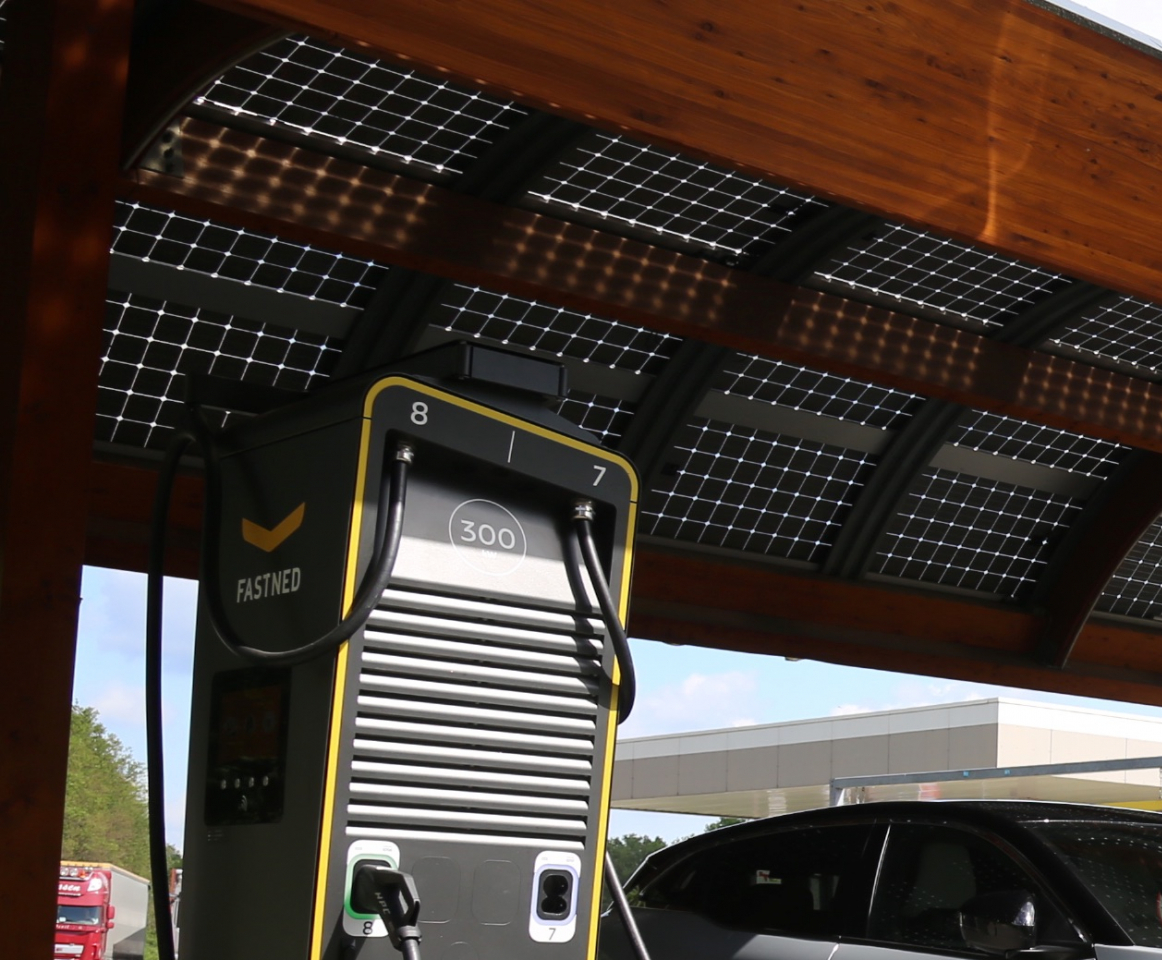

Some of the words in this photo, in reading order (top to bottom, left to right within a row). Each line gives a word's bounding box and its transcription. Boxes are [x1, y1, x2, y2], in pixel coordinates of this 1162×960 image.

[410, 401, 429, 426] 8
[592, 464, 608, 487] 7
[460, 519, 516, 550] 300
[236, 566, 302, 604] FASTNED
[362, 921, 373, 935] 8
[548, 927, 557, 940] 7
